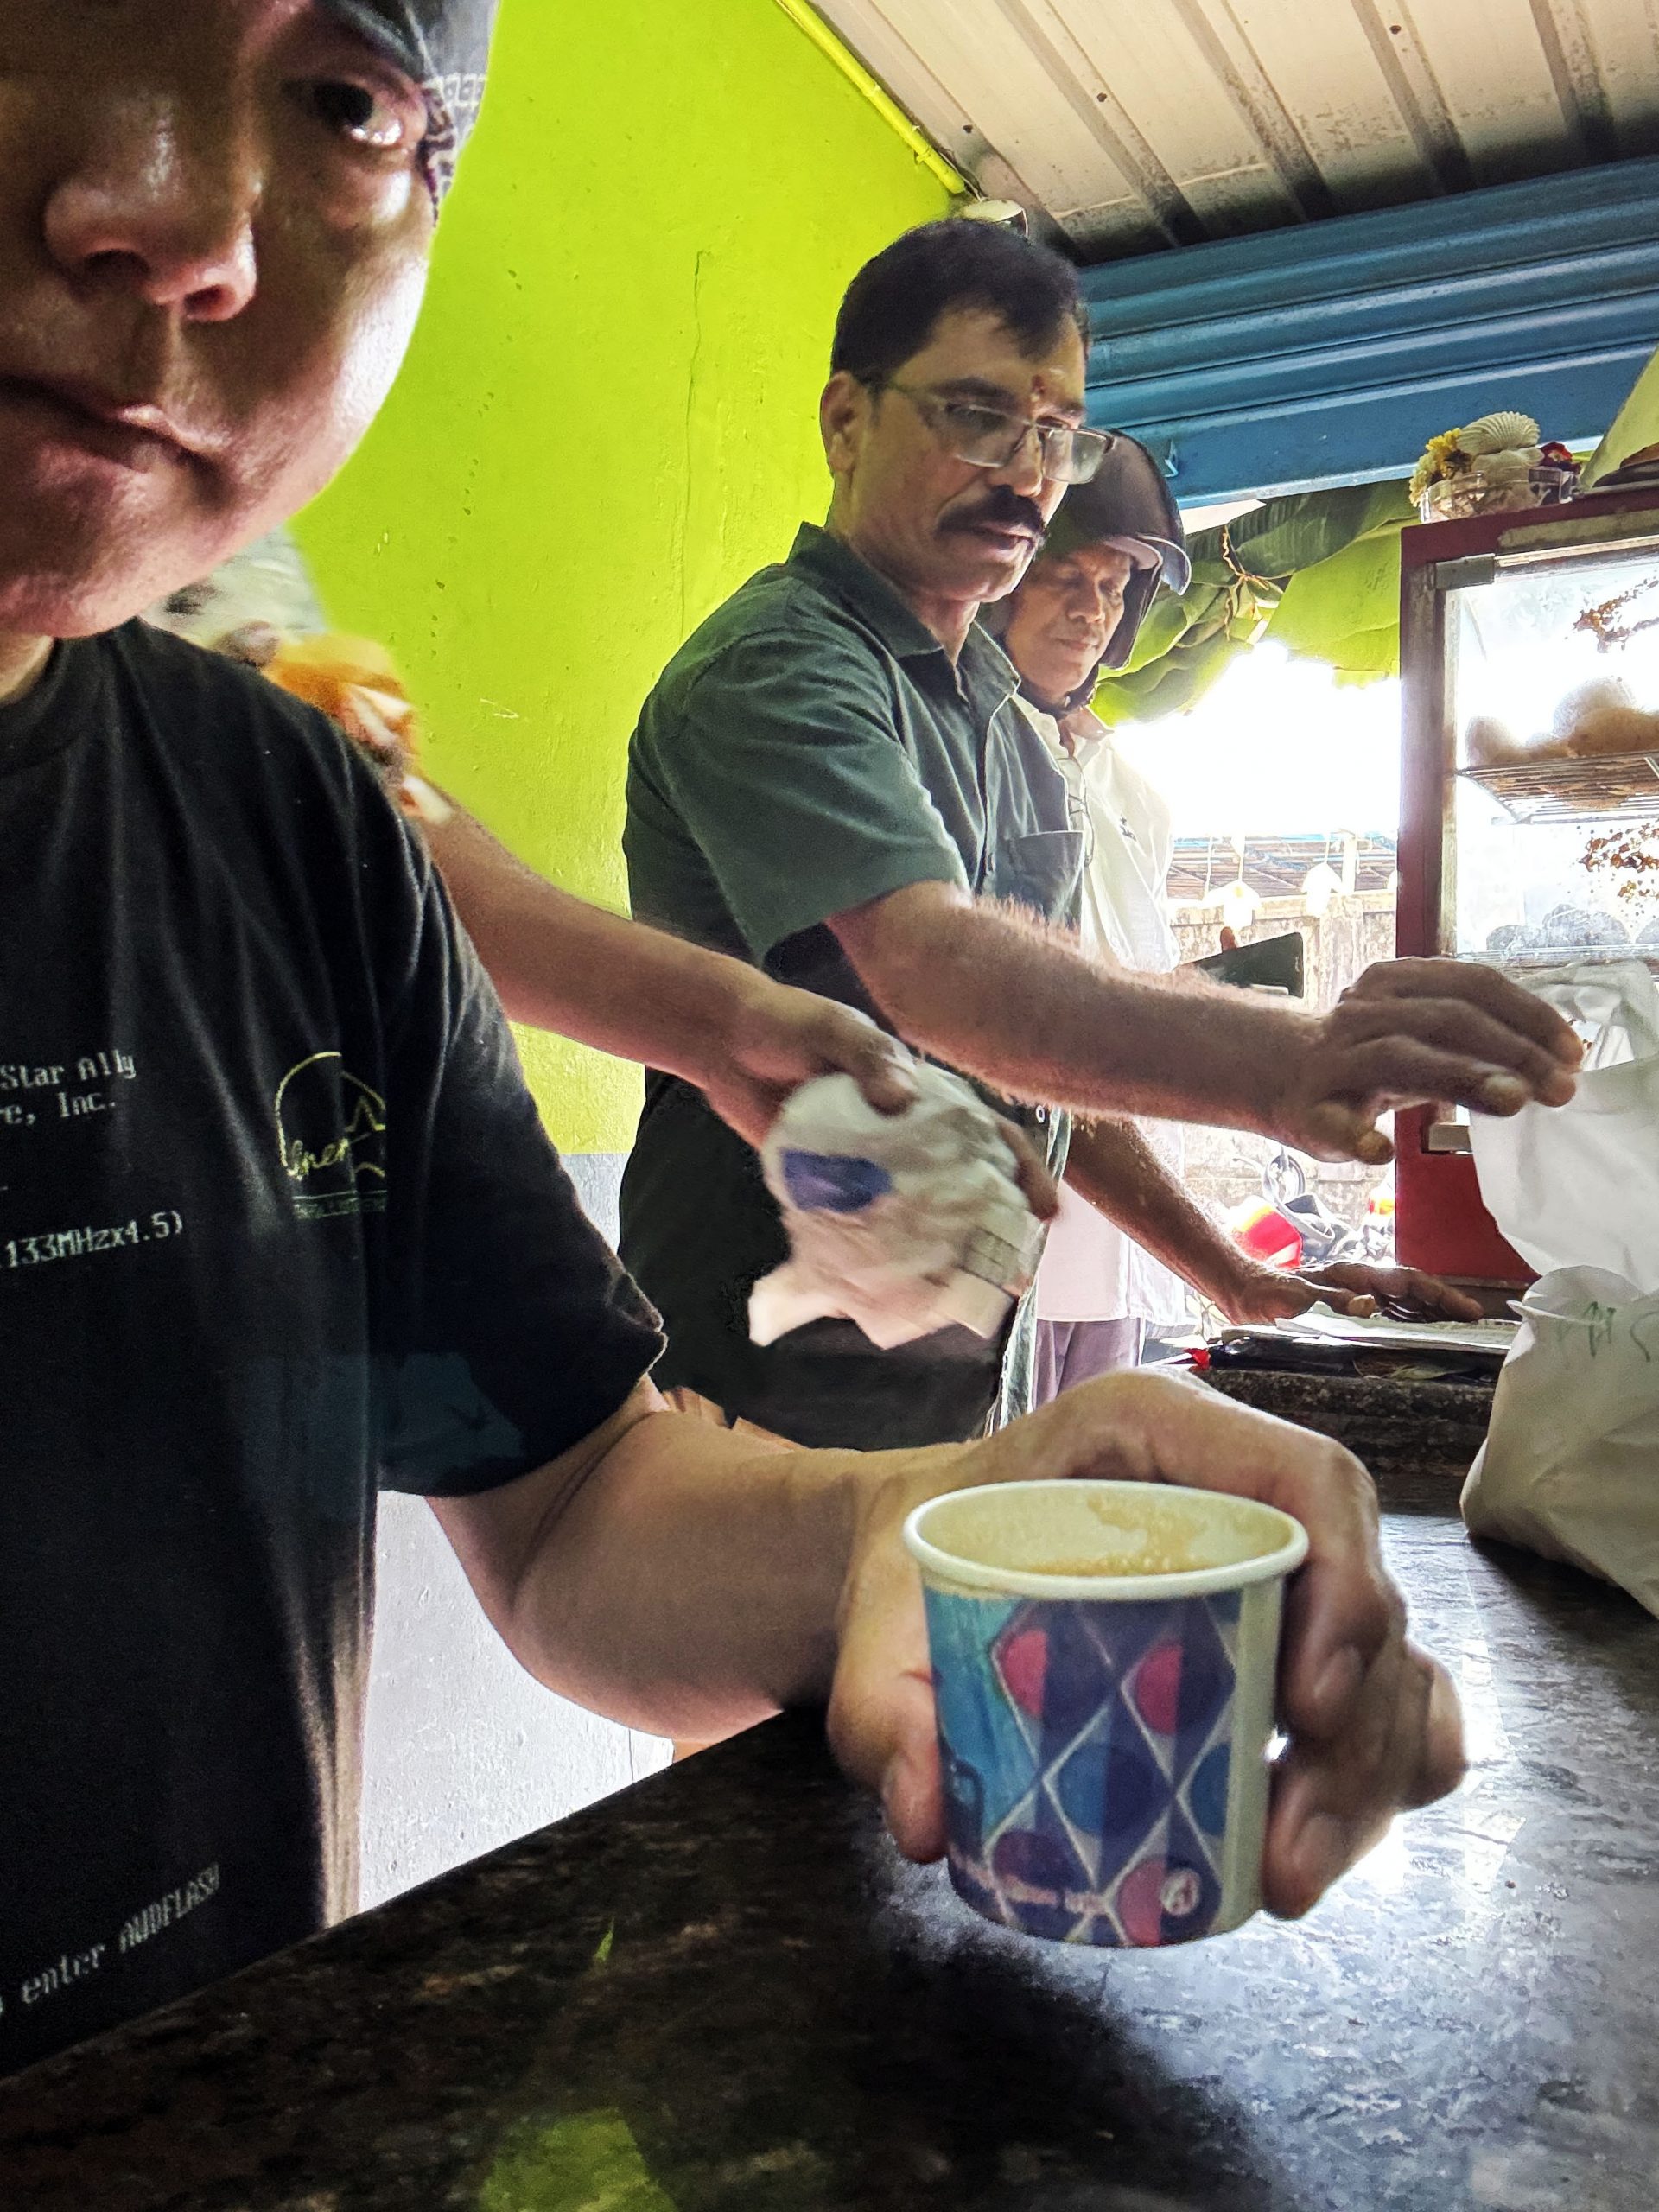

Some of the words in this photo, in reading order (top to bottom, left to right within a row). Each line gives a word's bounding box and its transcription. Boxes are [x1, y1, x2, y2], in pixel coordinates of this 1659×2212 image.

[0, 1064, 65, 1090] Star
[77, 1048, 137, 1080] Ally
[57, 1090, 116, 1118] Inc.
